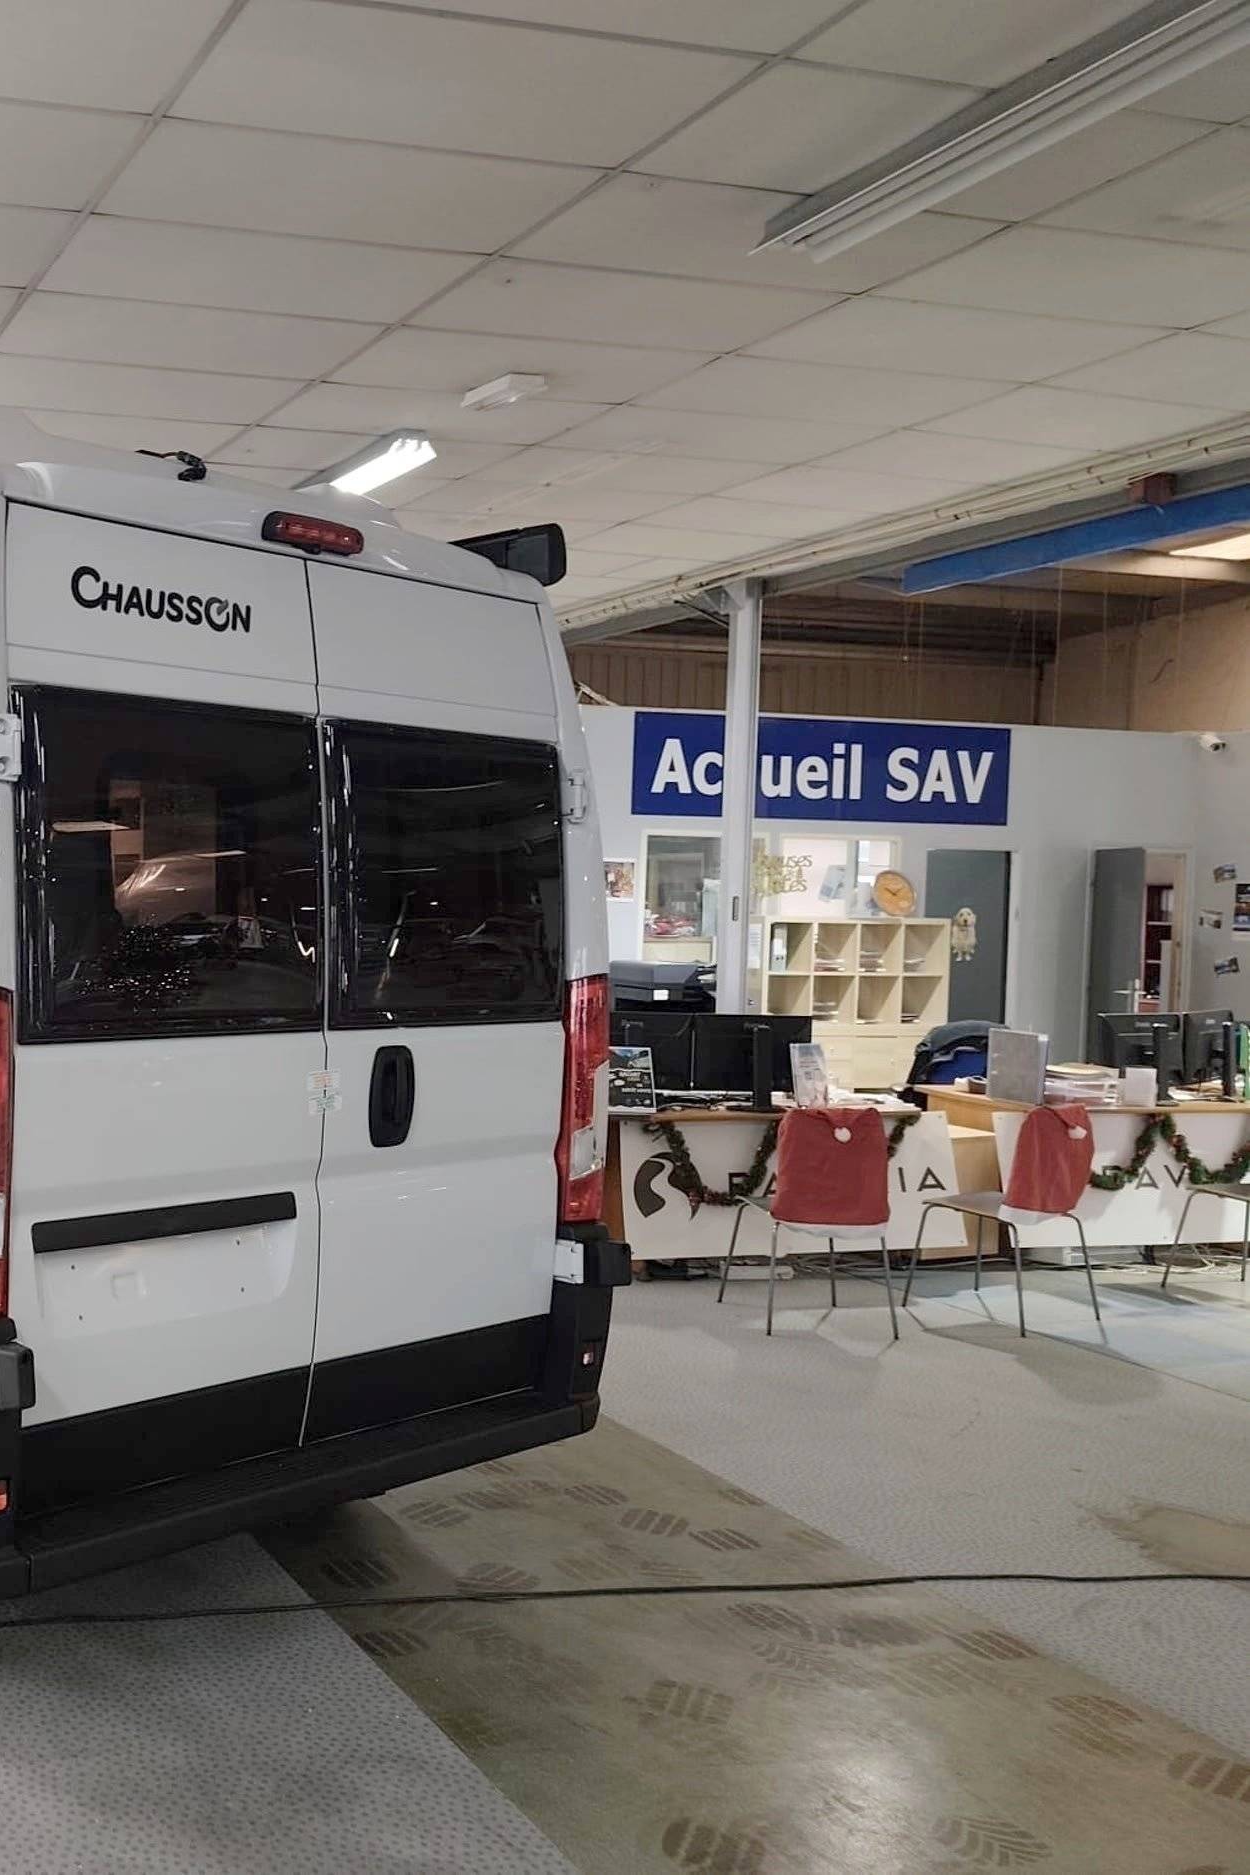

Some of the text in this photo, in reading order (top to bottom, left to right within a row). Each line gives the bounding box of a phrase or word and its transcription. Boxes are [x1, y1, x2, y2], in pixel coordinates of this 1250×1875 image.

[70, 565, 251, 633] CHAUSSON
[651, 738, 994, 804] Acueil SAV
